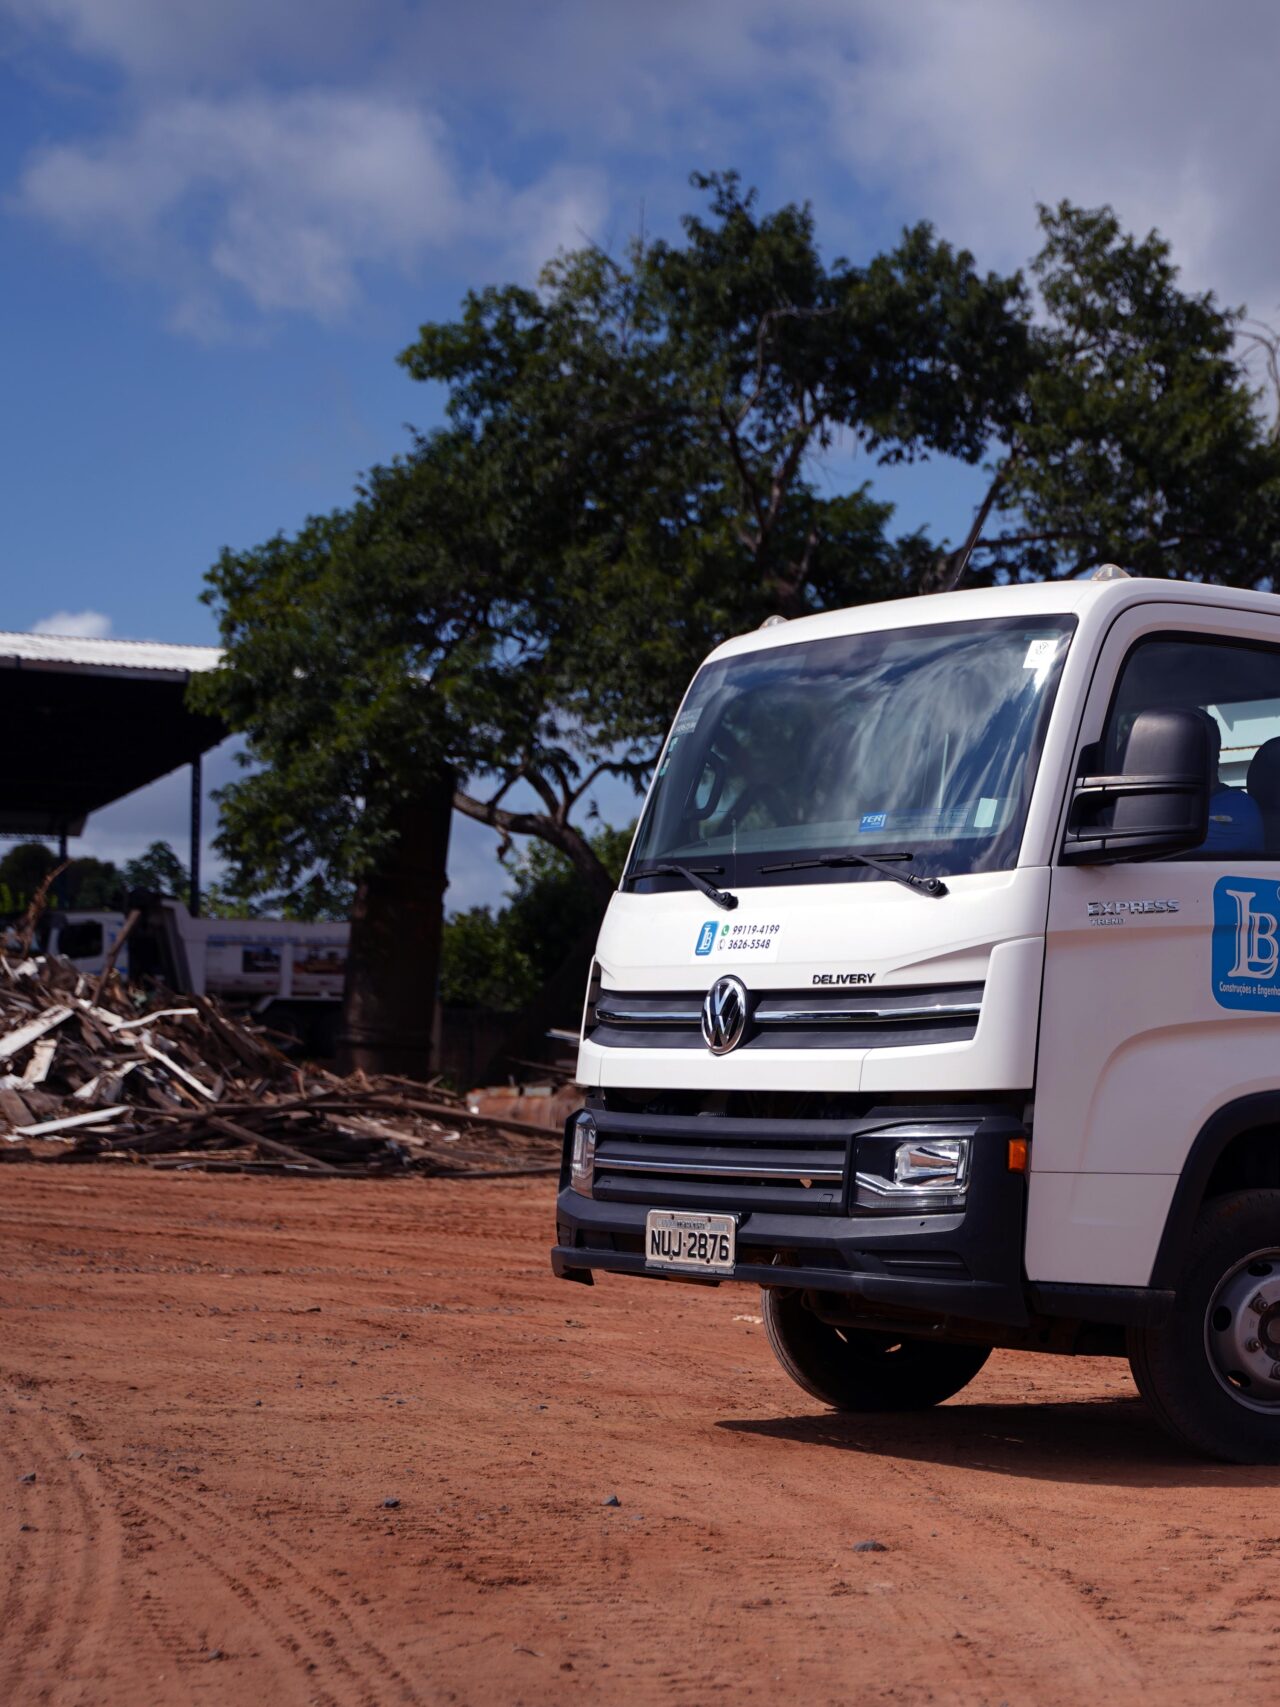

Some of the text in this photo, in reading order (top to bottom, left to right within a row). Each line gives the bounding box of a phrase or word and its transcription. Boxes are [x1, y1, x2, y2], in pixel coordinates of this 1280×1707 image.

[1087, 900, 1180, 916] EXPRESS
[1090, 918, 1126, 926] TREND
[732, 924, 780, 935] 99119-4199
[728, 939, 771, 950] 3626-5548
[812, 973, 876, 985] DELIVERY
[1219, 981, 1252, 996] Construções
[1252, 986, 1257, 994] e
